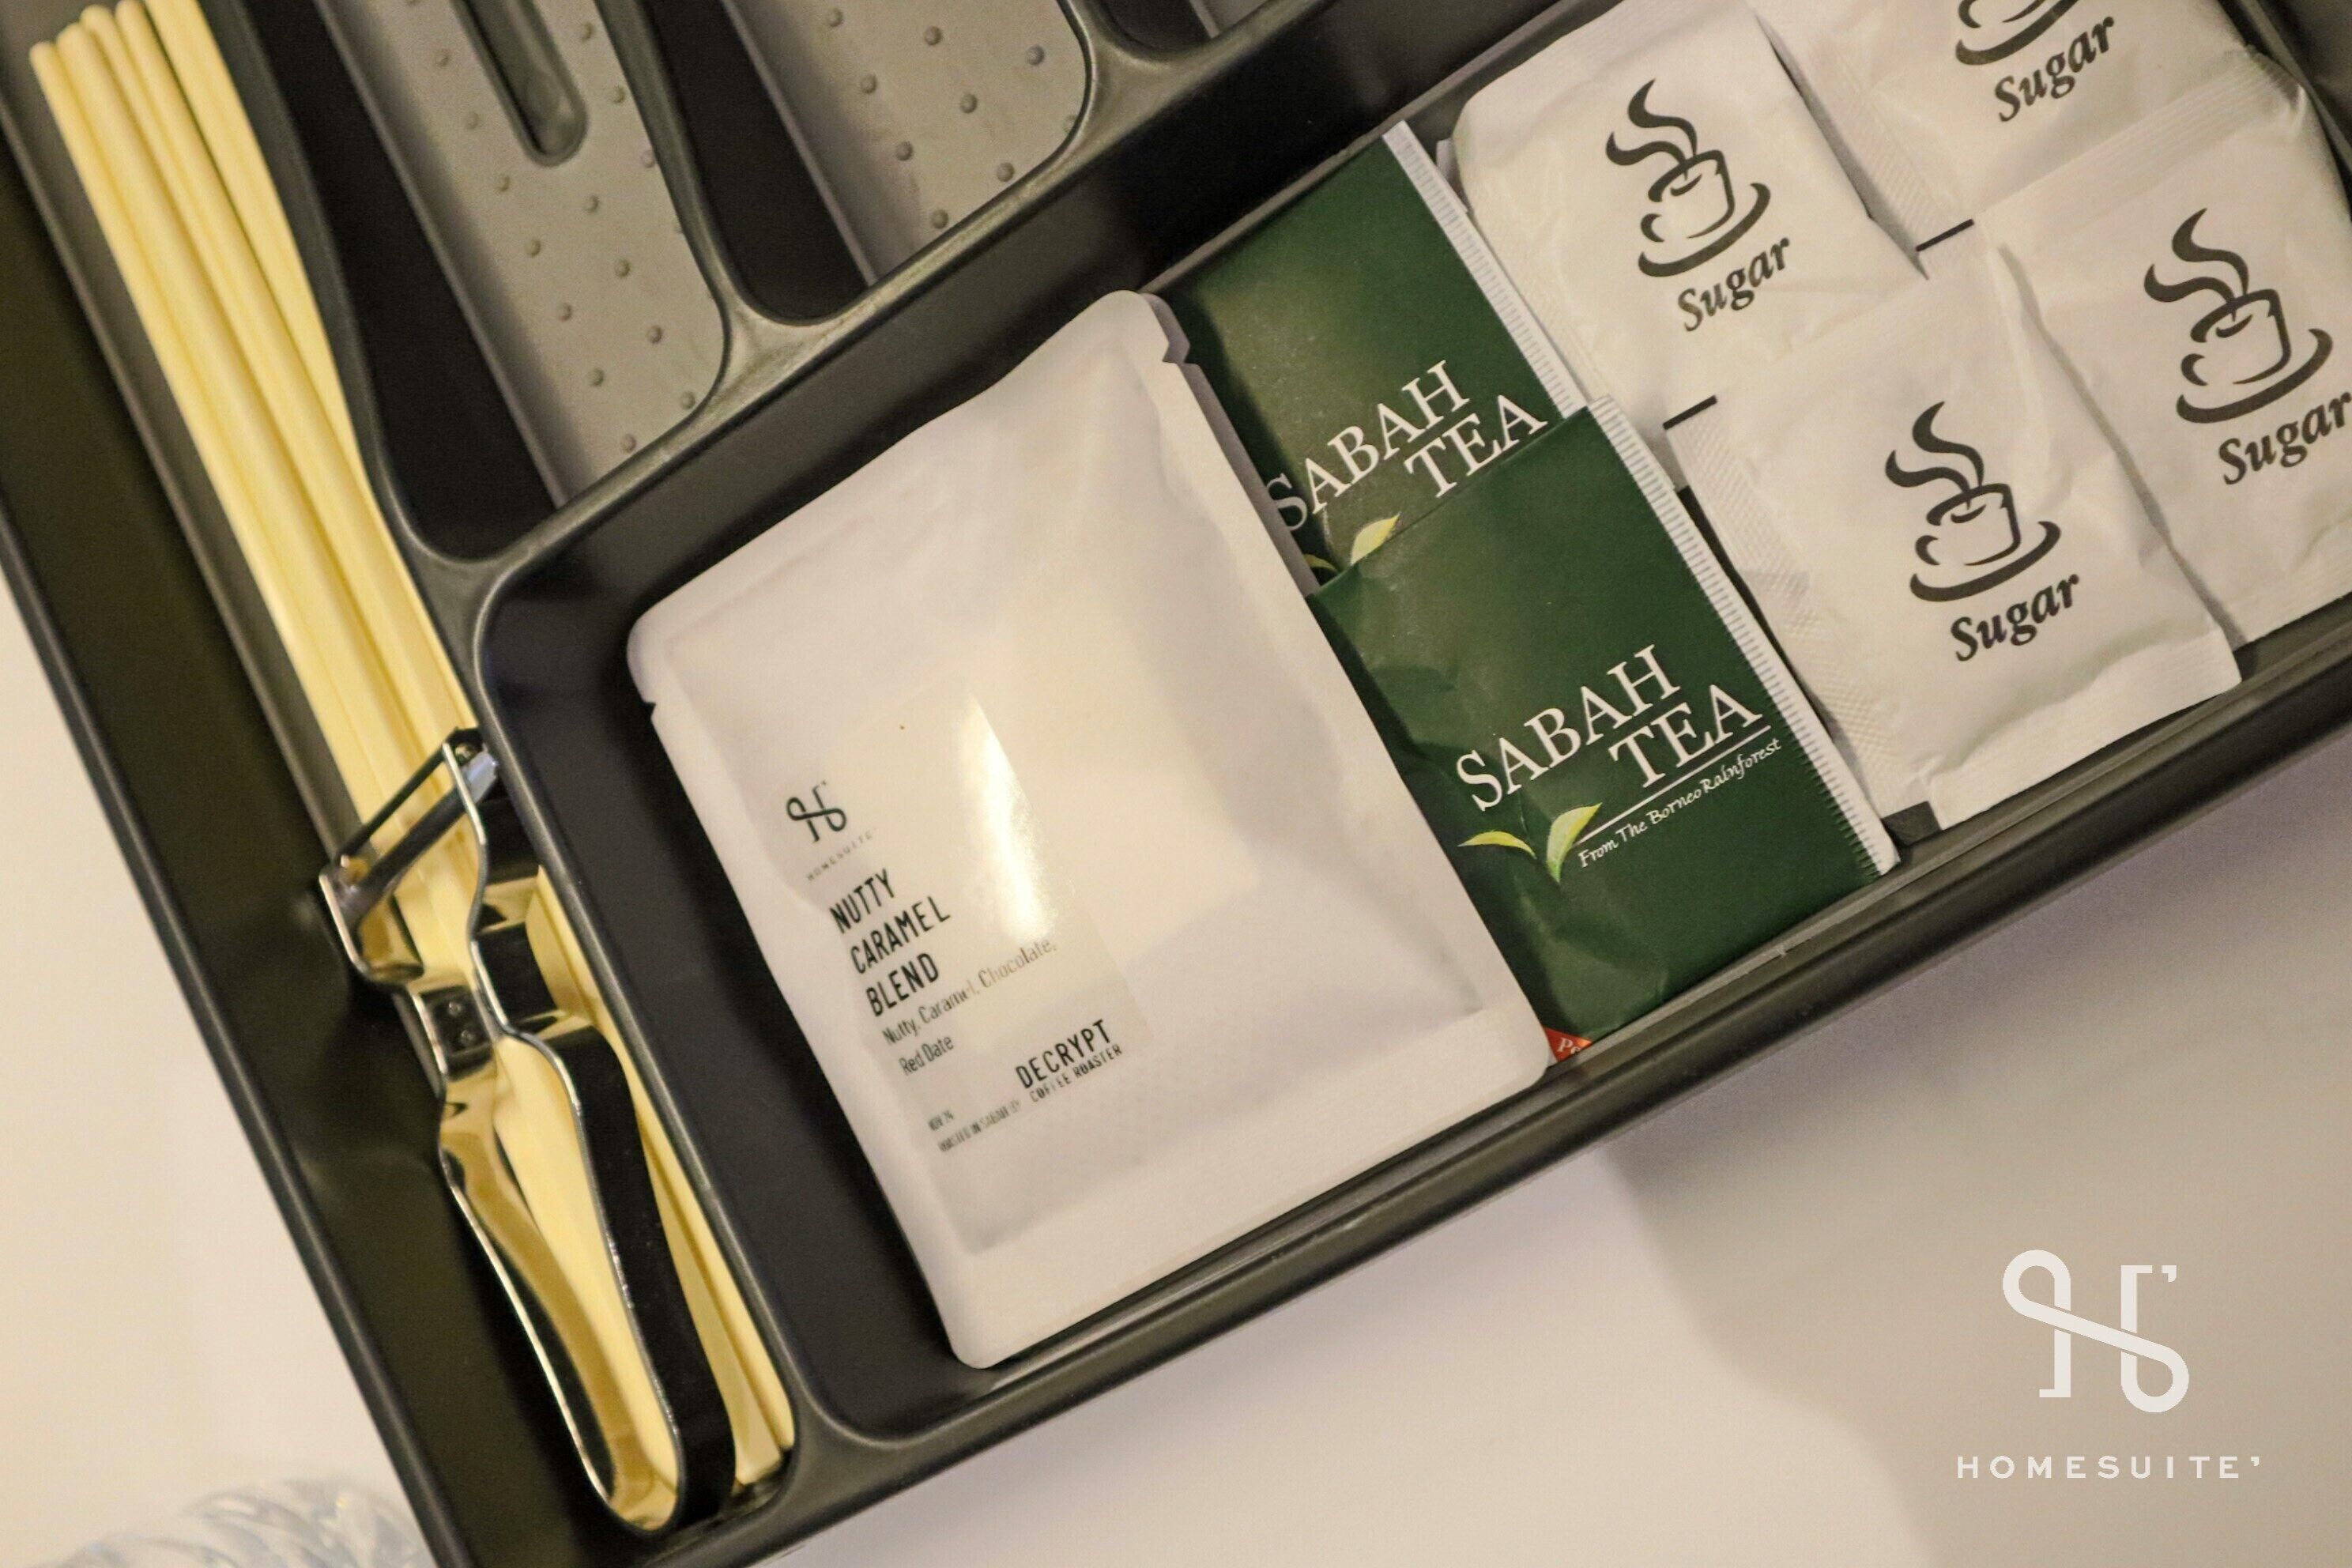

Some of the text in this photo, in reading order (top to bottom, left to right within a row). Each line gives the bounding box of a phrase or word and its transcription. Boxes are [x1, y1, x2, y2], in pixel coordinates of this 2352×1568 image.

[1994, 16, 2115, 122] Sugar
[1678, 237, 1790, 332] Sugar
[1266, 360, 1470, 531] SABAH
[1403, 394, 1548, 499] TEA
[2218, 391, 2352, 485] Sugar
[1951, 574, 2080, 662] Sugar
[1457, 644, 1681, 812] SABAH
[1608, 684, 1762, 789] TEA
[1578, 737, 1782, 868] From The Borneo Rainforest
[829, 869, 895, 933] NUTTY
[850, 896, 951, 974] CARAMEL
[865, 952, 939, 1017] BLEND
[898, 1035, 955, 1076] Red Date
[1015, 1019, 1110, 1089] DECRYPT
[1072, 1043, 1122, 1078] ROASTER
